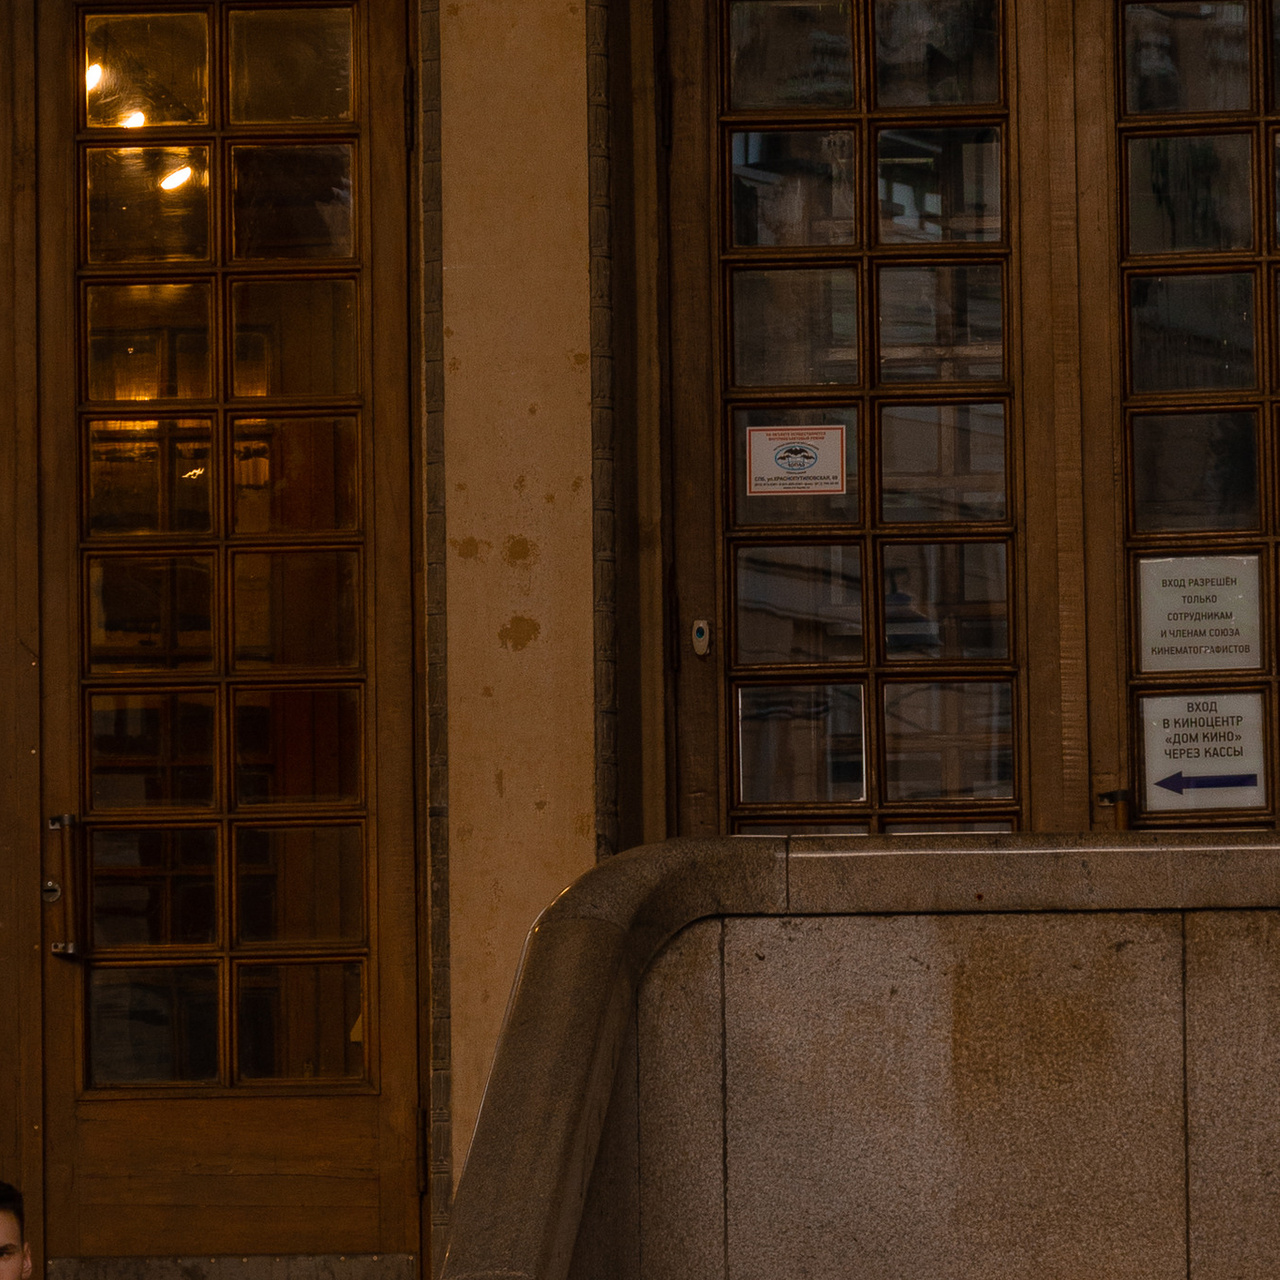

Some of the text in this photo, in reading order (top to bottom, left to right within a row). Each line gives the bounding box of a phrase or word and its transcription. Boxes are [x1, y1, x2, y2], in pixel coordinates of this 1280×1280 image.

[1162, 577, 1237, 588] ВХОД РАЗРЕШЁН
[1182, 594, 1217, 604] ТОЛЬКО
[1167, 612, 1233, 622] СОТРУДНИКАМ
[1160, 628, 1240, 638] И ЧЛЕНАМ СОЮЗА
[1151, 645, 1251, 655] КИНЕМАТОГРАФИСТОВ
[1187, 701, 1218, 713] ВХОД
[1162, 715, 1243, 729] В КИНОЦЕНТР
[1165, 731, 1242, 745] «ДОМ КИНО»
[1164, 746, 1243, 759] ЧЕРЕЗ КАССЫ
